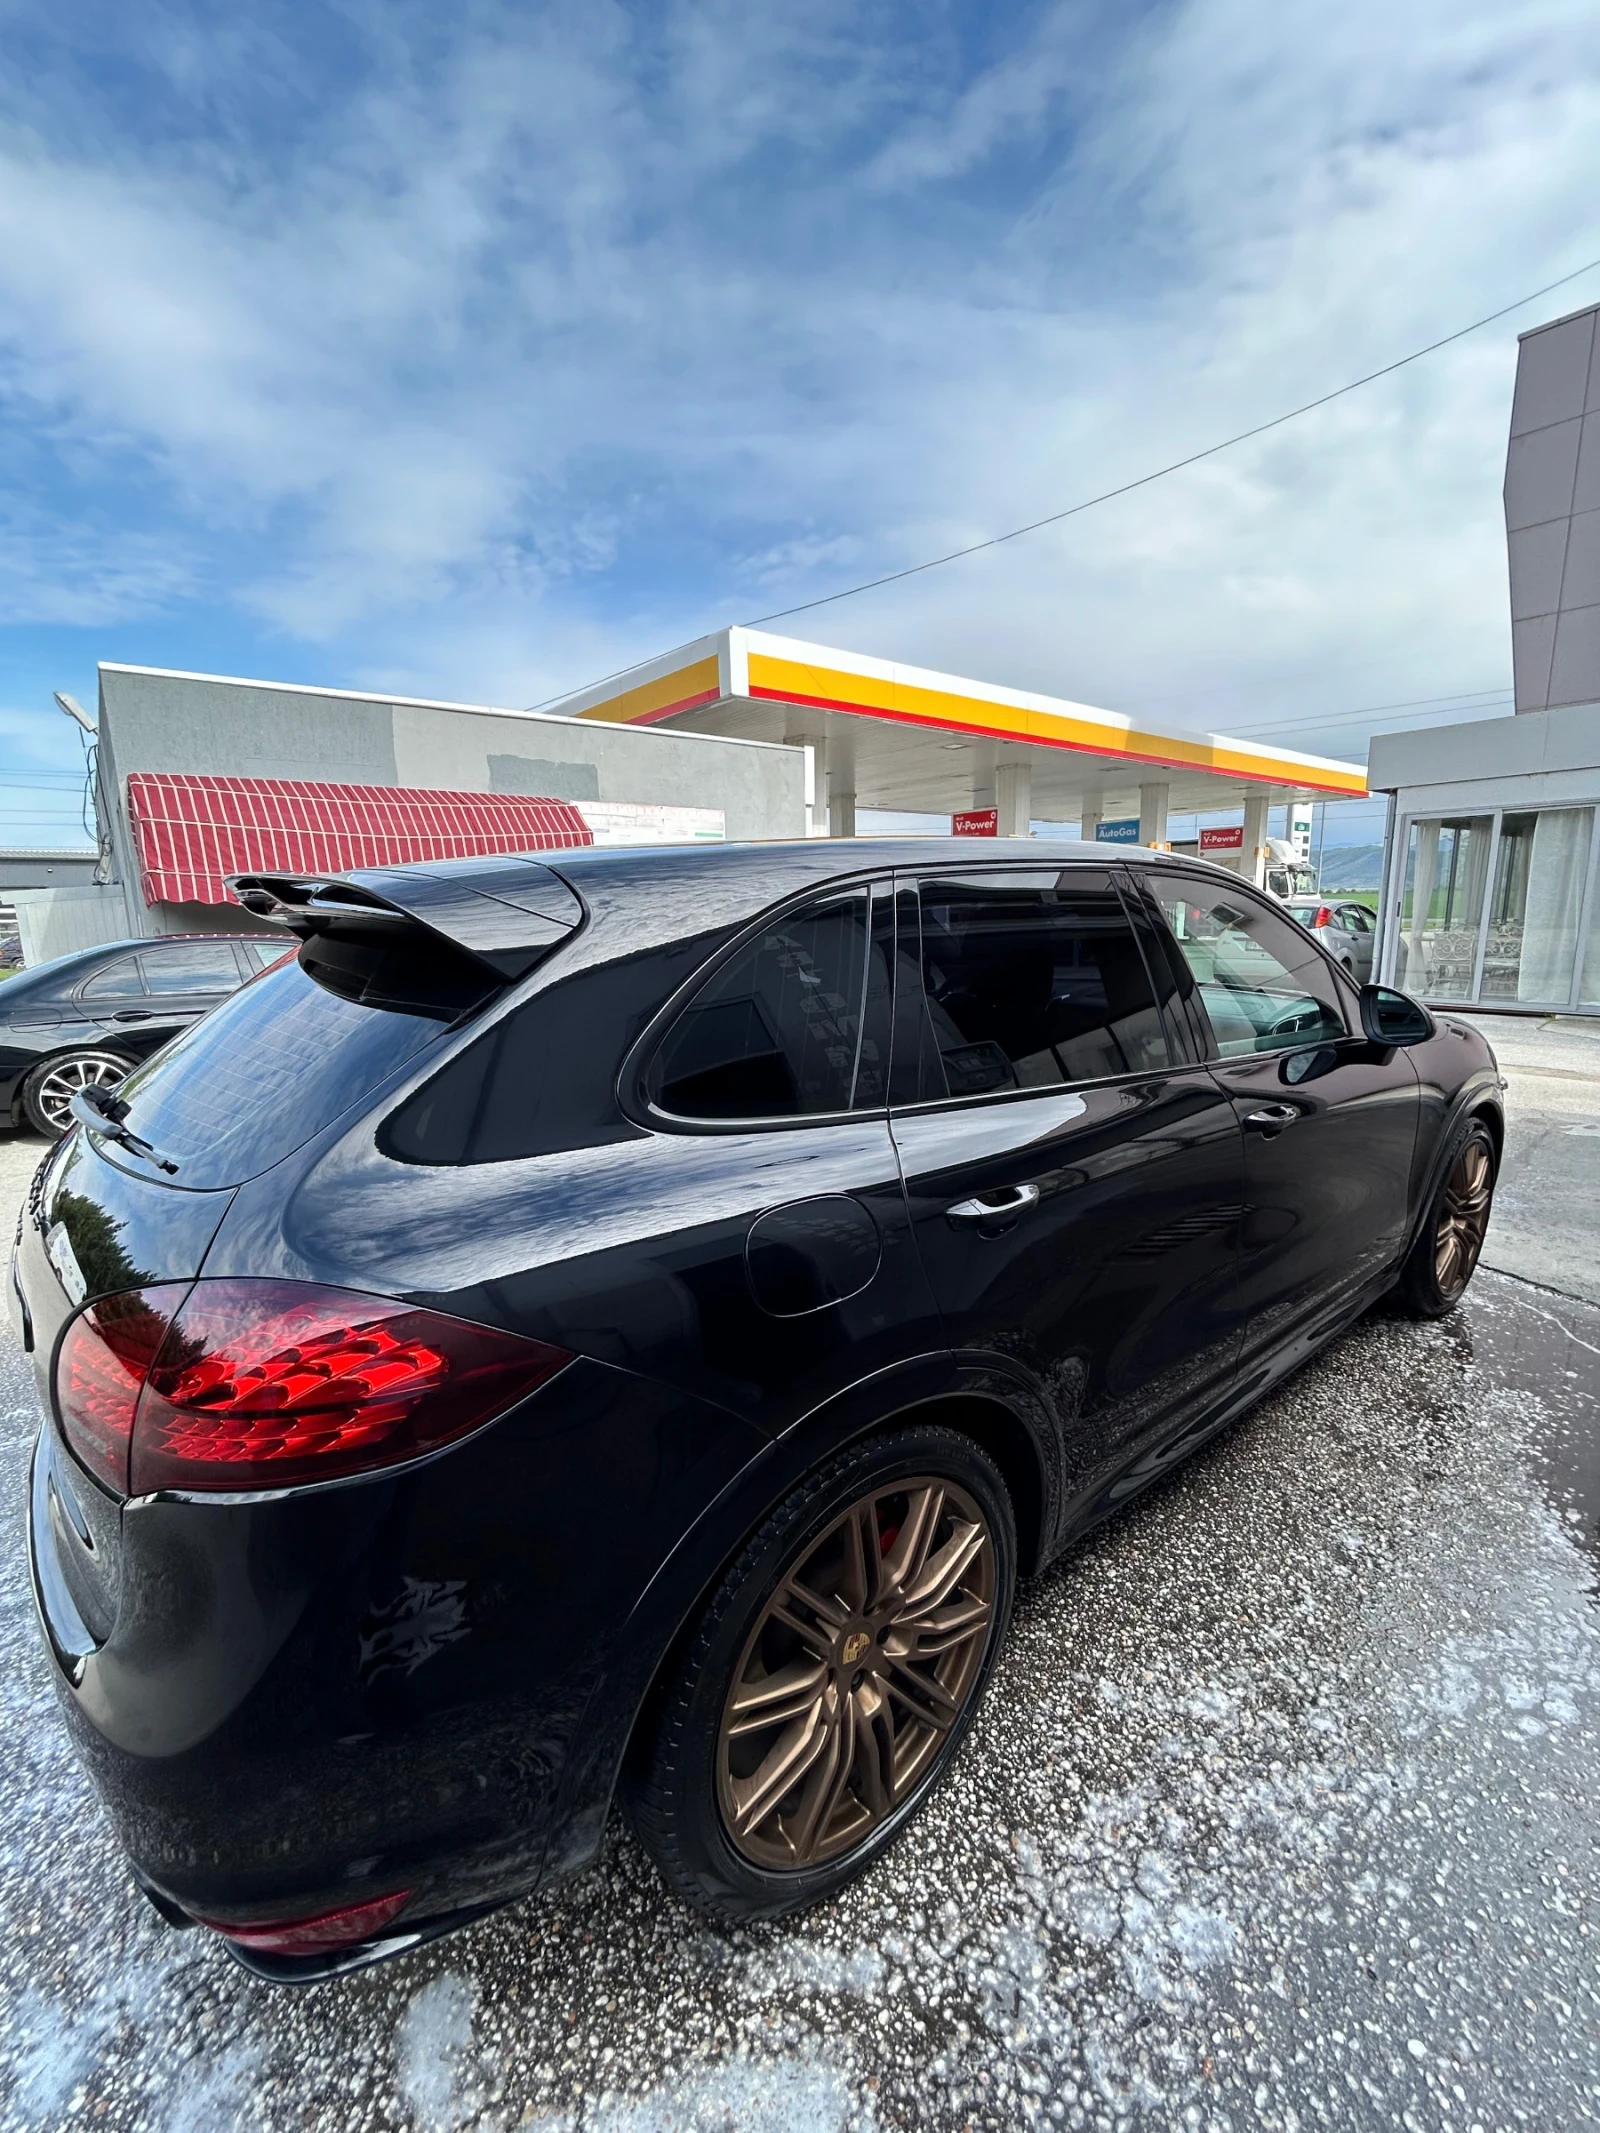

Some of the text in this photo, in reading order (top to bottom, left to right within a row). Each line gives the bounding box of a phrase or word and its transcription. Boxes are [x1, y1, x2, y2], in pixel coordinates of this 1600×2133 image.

[956, 820, 994, 831] V-Power
[1098, 827, 1136, 838] AutoGas
[1203, 835, 1239, 843] V-Power
